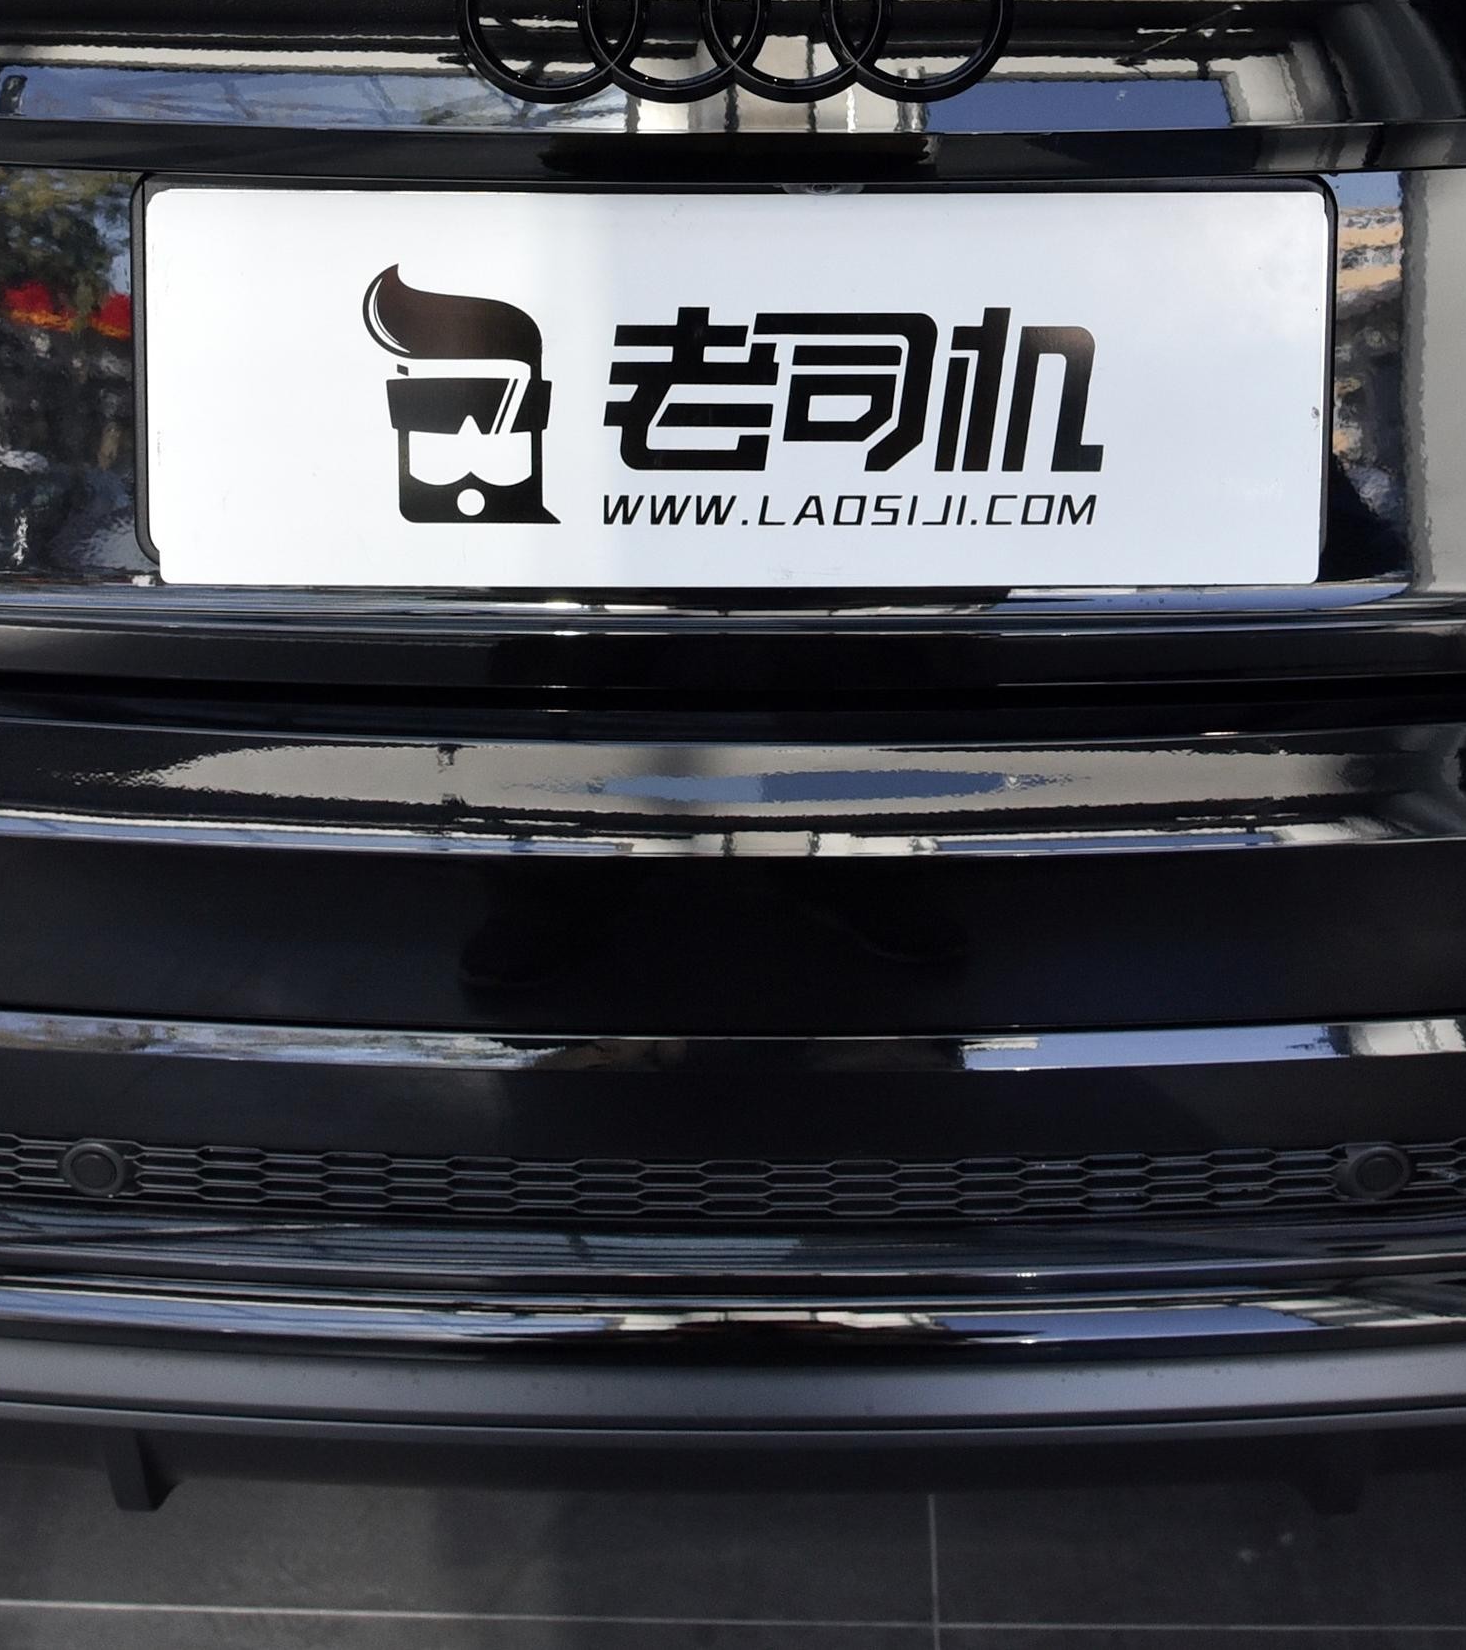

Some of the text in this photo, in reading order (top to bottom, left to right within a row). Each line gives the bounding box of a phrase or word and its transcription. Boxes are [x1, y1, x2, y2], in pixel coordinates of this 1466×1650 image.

[603, 306, 1103, 472] 老司机
[602, 493, 1098, 527] WWW.LAOSIJI.COM
